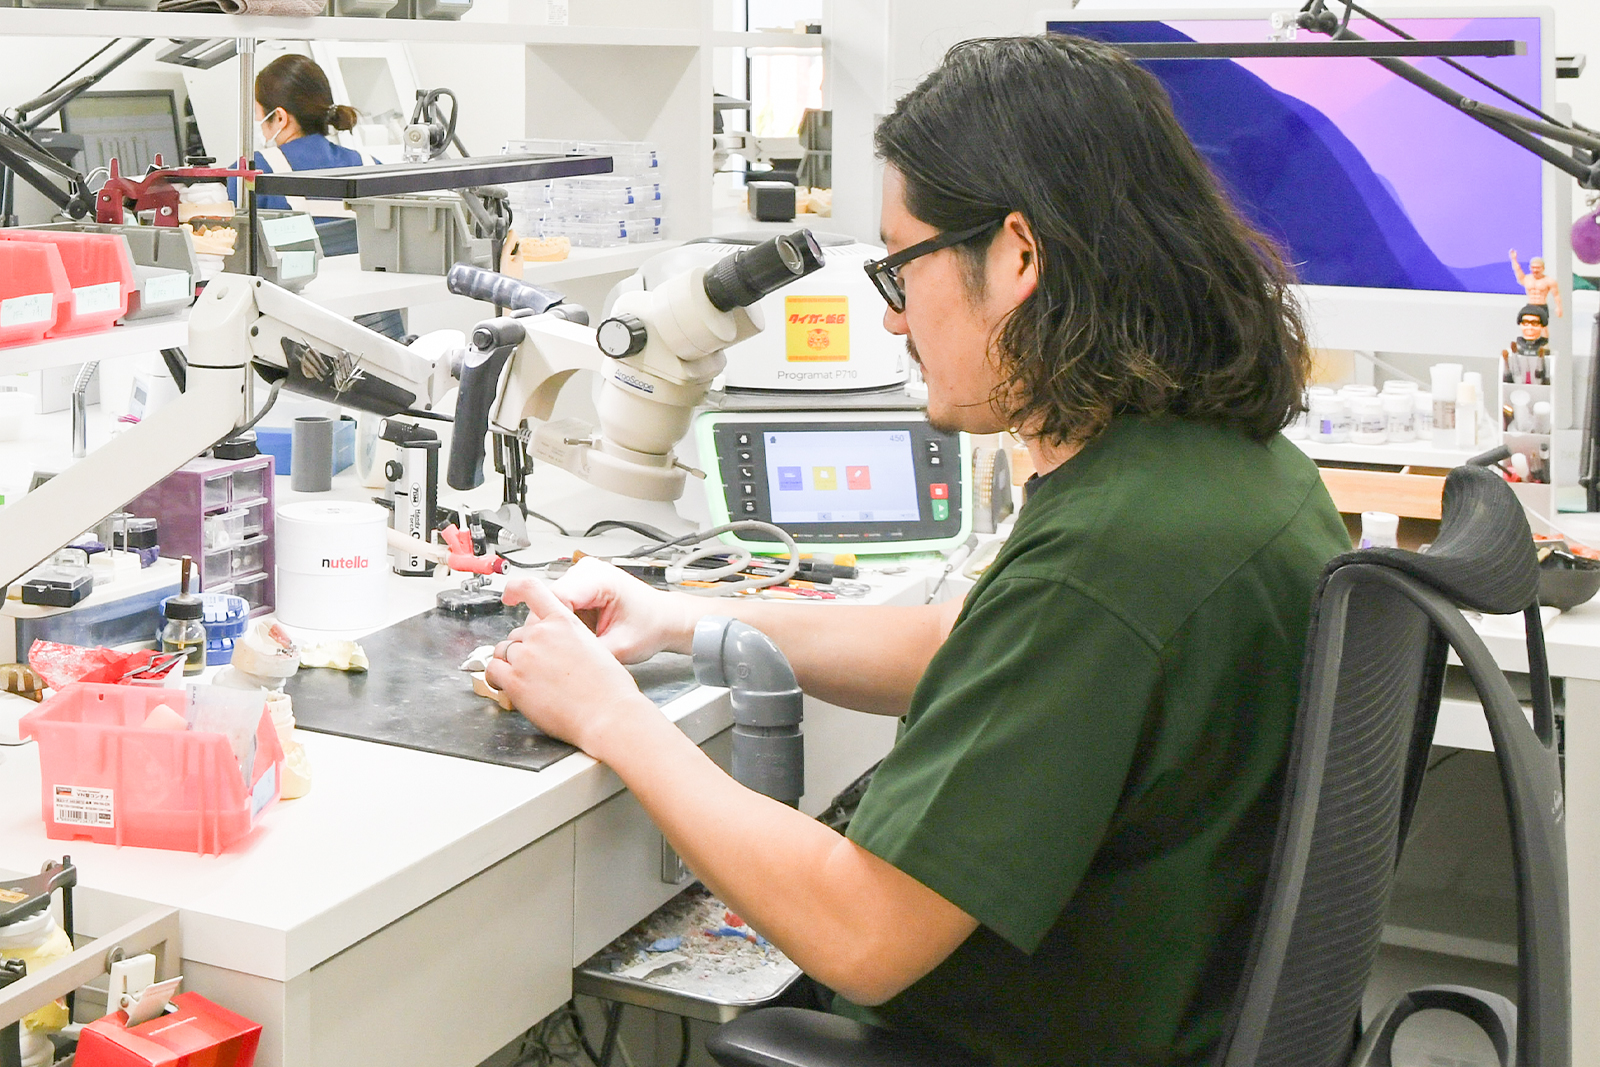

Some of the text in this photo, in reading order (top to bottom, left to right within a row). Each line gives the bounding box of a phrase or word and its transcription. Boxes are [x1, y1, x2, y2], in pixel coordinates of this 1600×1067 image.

[615, 369, 654, 391] ArgoScope
[777, 370, 858, 382] Programat P710
[321, 555, 369, 569] nutella
